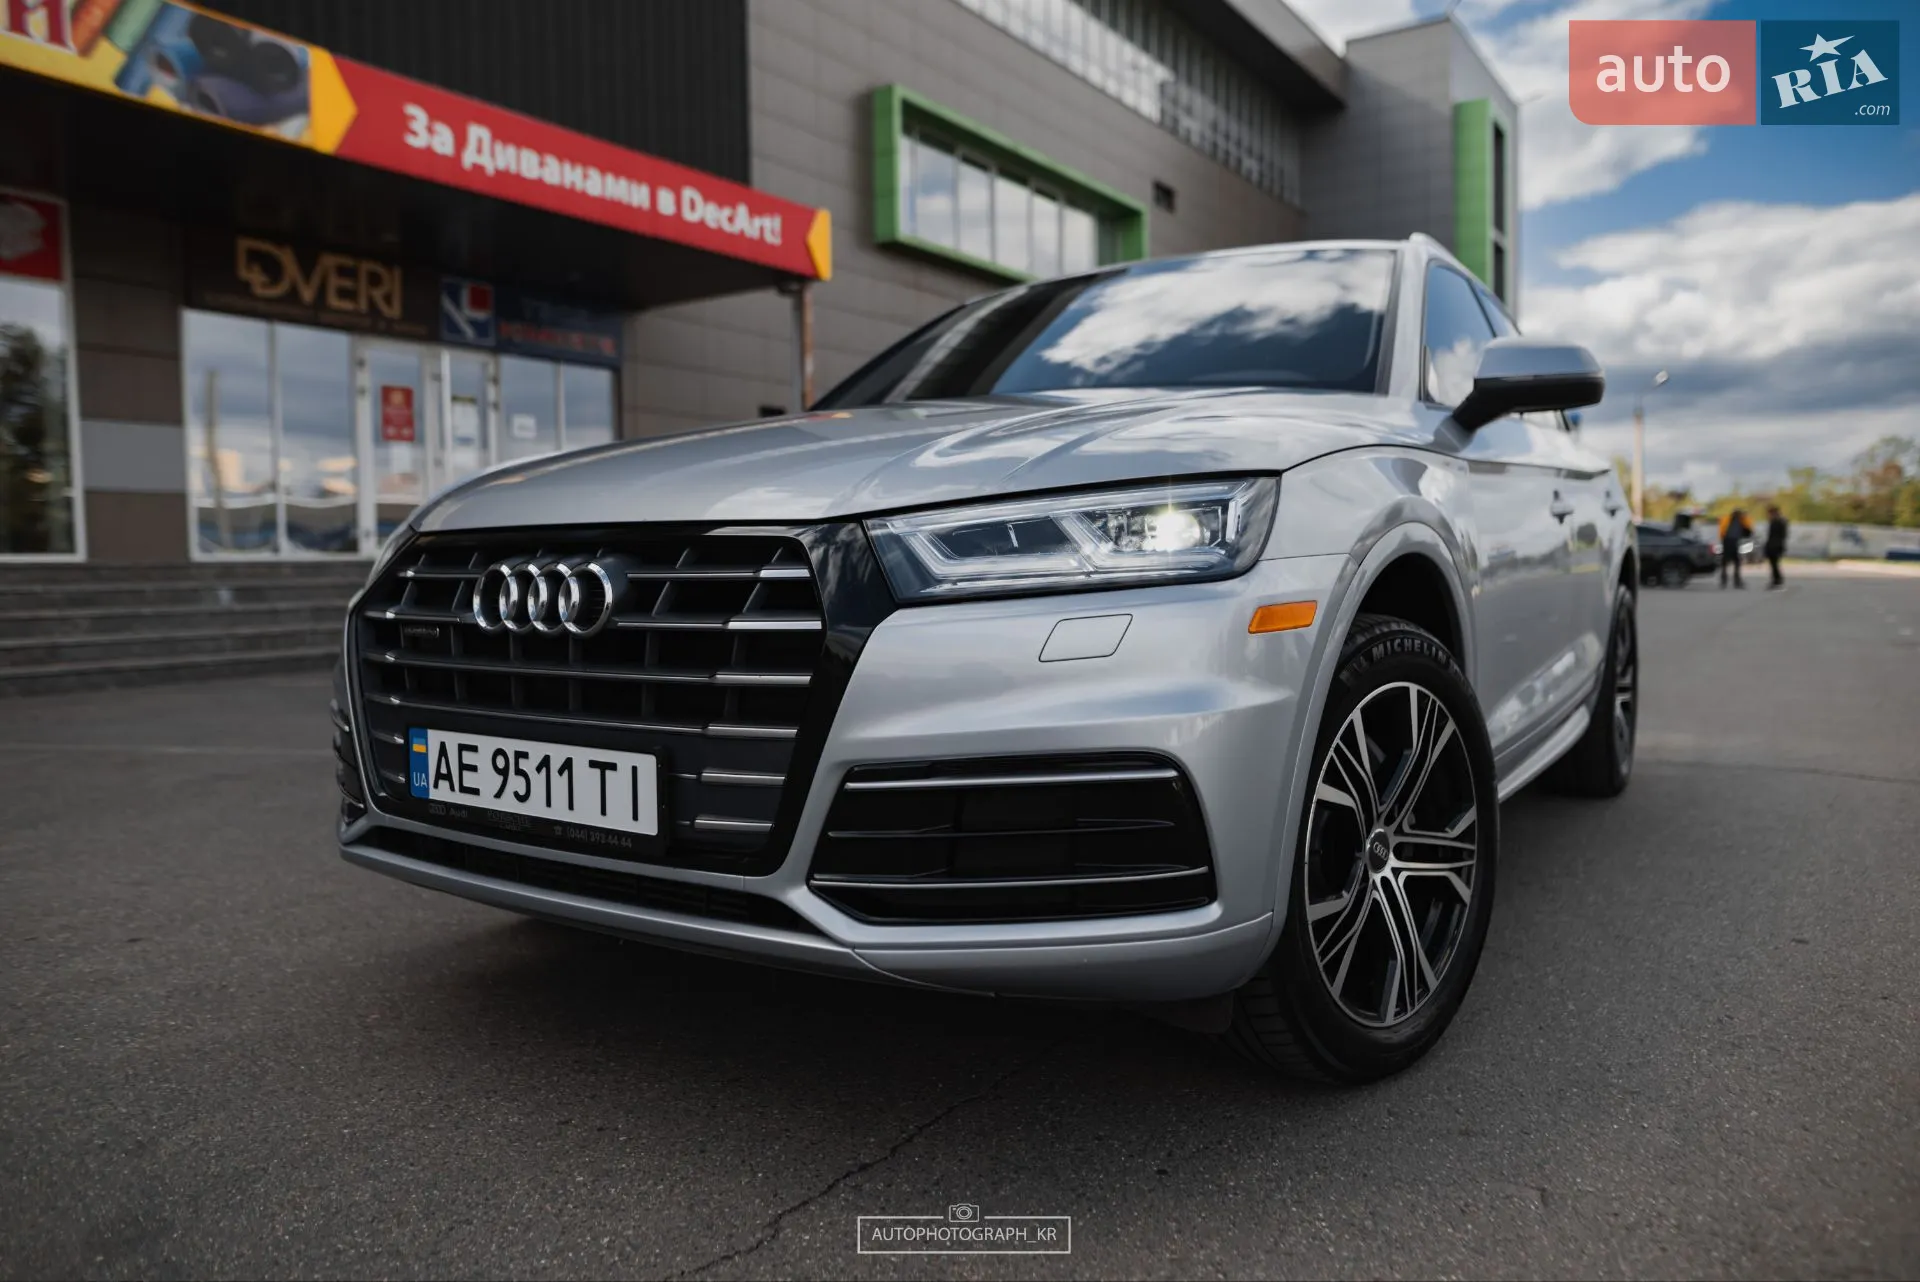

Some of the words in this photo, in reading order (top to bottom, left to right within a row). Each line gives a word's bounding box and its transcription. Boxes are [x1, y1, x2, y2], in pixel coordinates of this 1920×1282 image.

[403, 103, 456, 158] За
[461, 122, 651, 211] Диванами
[656, 187, 677, 216] в
[680, 174, 782, 246] DecArt!
[236, 238, 402, 320] DVERI
[1371, 637, 1447, 664] MICHELIN
[413, 772, 428, 788] UA
[433, 741, 480, 796] AE
[491, 747, 575, 811] 9511
[588, 759, 639, 822] TI
